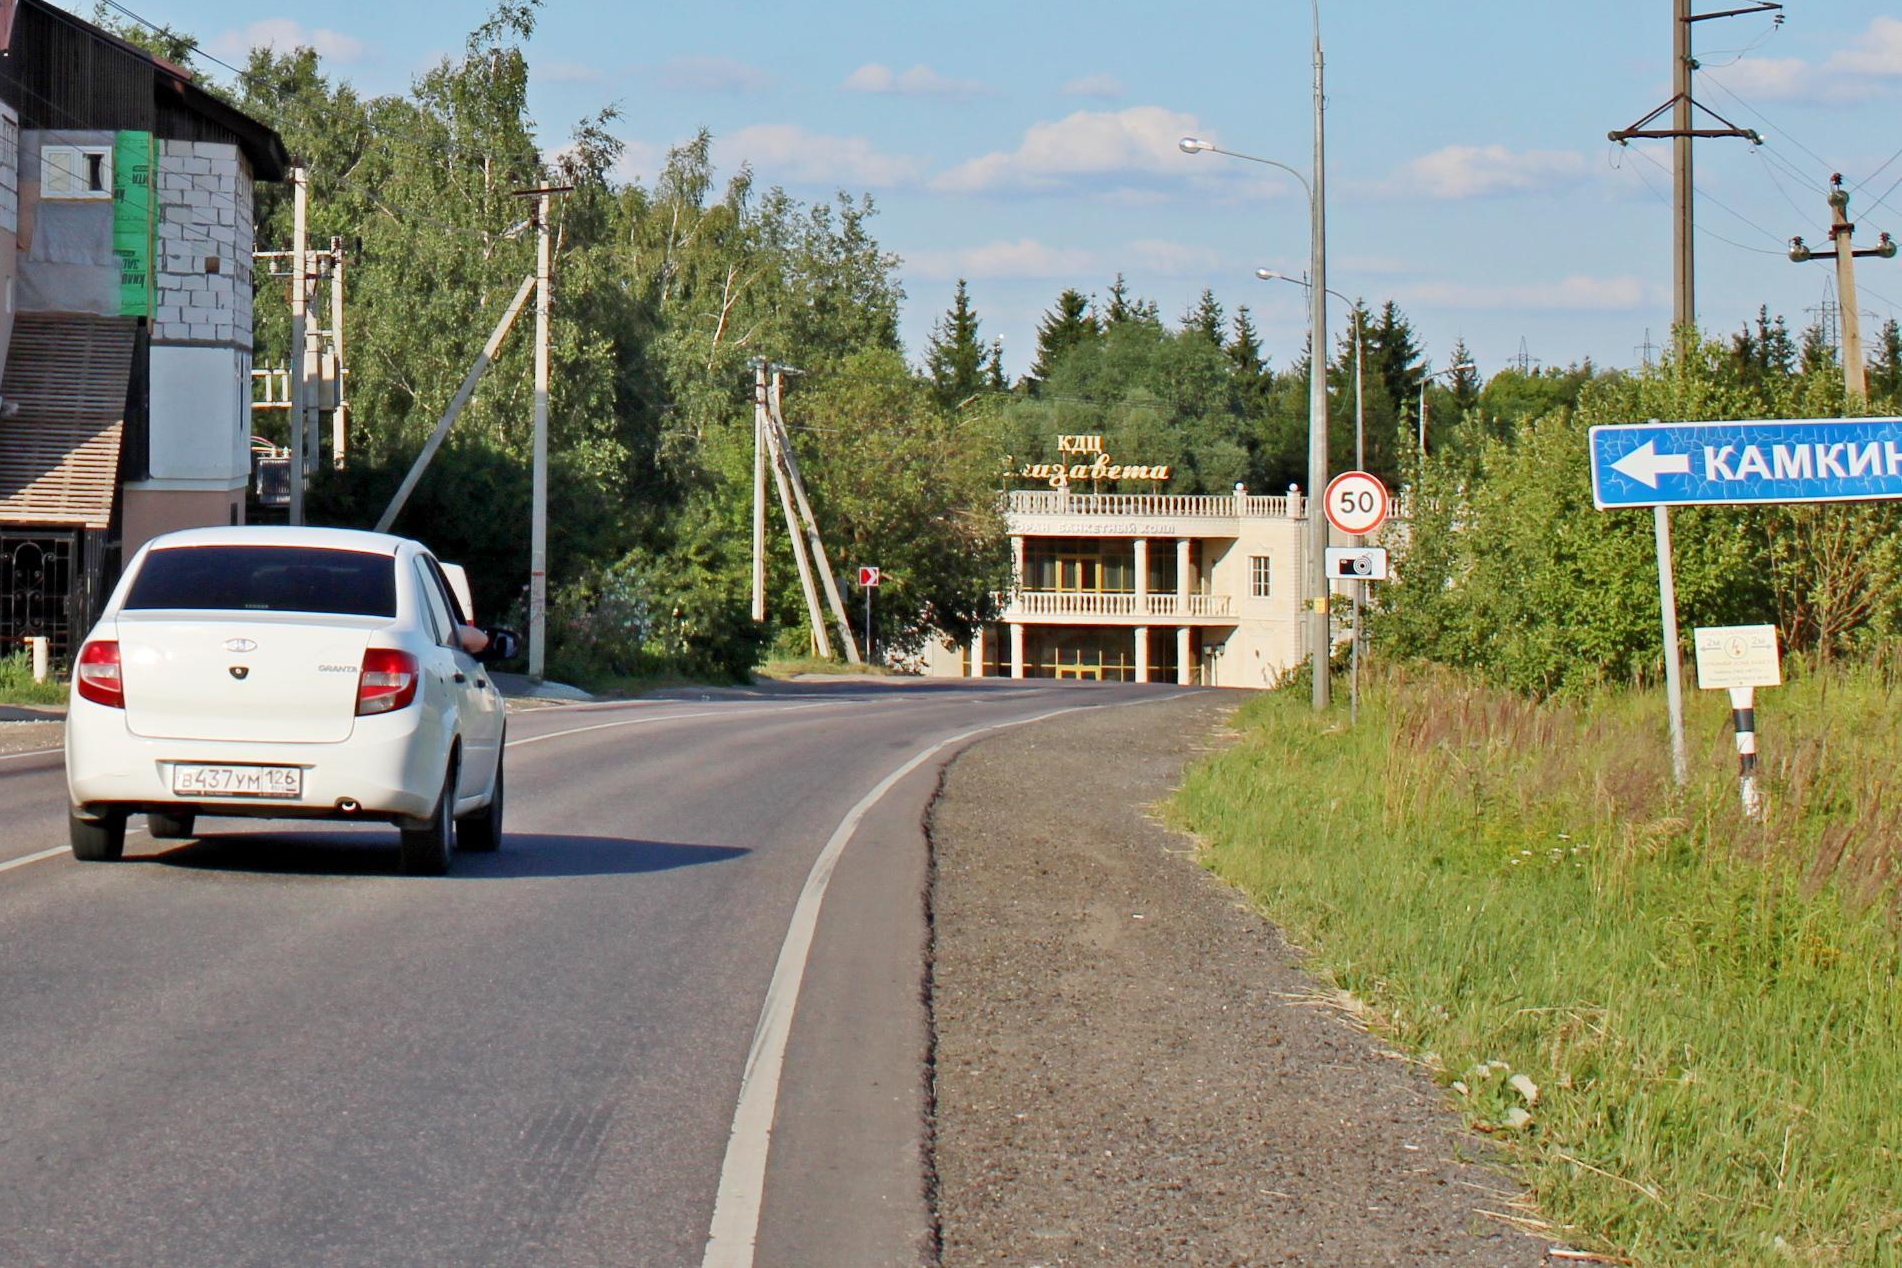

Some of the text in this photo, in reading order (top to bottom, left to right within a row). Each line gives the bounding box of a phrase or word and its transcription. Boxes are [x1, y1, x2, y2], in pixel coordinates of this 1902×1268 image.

[1057, 434, 1104, 454] КДЦ
[1340, 491, 1373, 514] 50
[318, 664, 358, 673] GRANTA
[265, 769, 296, 785] 126
